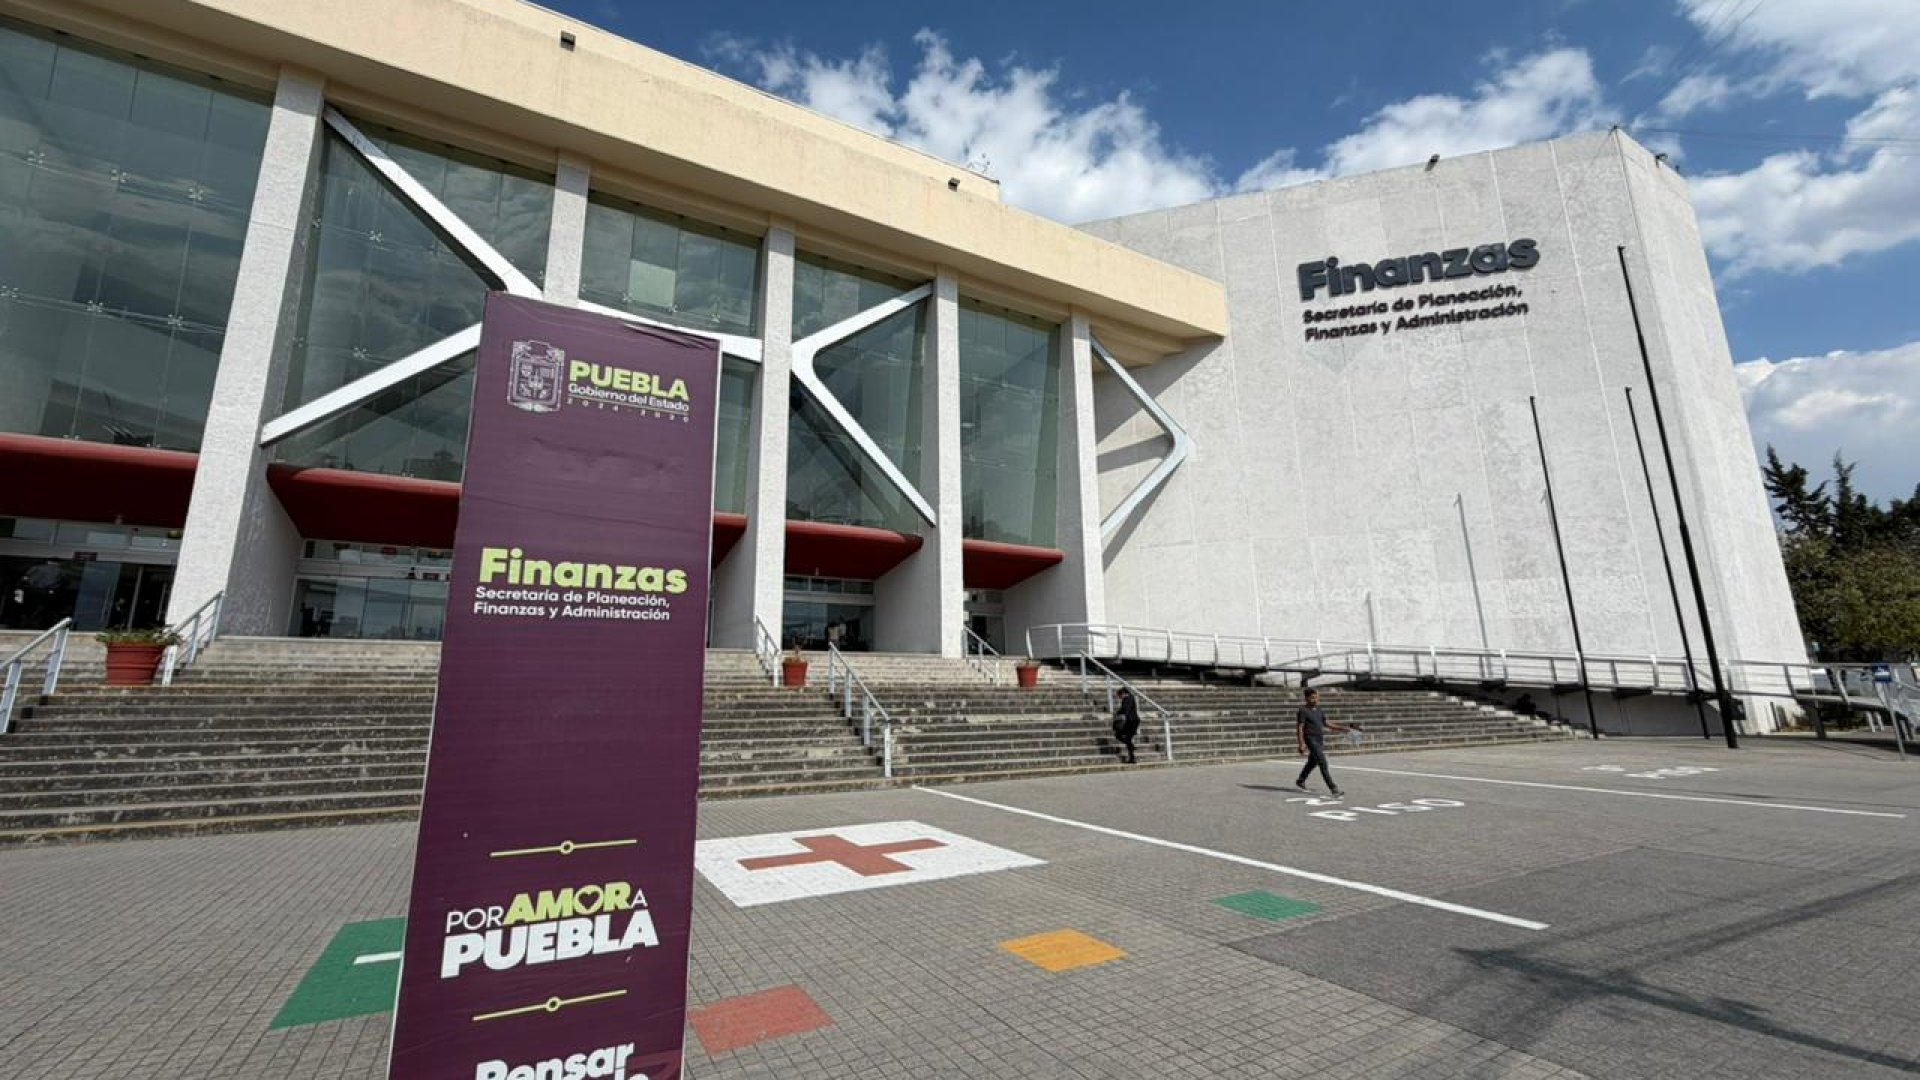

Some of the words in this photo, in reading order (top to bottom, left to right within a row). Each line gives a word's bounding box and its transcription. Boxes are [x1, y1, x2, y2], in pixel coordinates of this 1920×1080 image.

[1297, 238, 1541, 301] Finanzas
[1303, 298, 1389, 323] Secretaría
[1392, 297, 1415, 313] de
[1419, 284, 1522, 306] Planeación,
[1305, 322, 1377, 342] Finanzas
[1382, 319, 1392, 335] y
[1396, 301, 1529, 332] Administración
[568, 383, 627, 401] Gobierno
[628, 393, 648, 405] del
[649, 397, 690, 412] Estado
[569, 359, 690, 402] PUEBLA
[479, 547, 688, 594] Finanzas
[473, 602, 545, 616] Finanzas
[549, 606, 559, 619] y
[562, 604, 670, 621] Administración
[475, 586, 559, 602] Secretaría
[563, 591, 583, 604] de
[587, 591, 670, 608] Planeación,
[445, 905, 505, 933] POR
[503, 881, 632, 926] AMOR
[631, 888, 649, 908] A
[440, 909, 660, 979] PUEBLA
